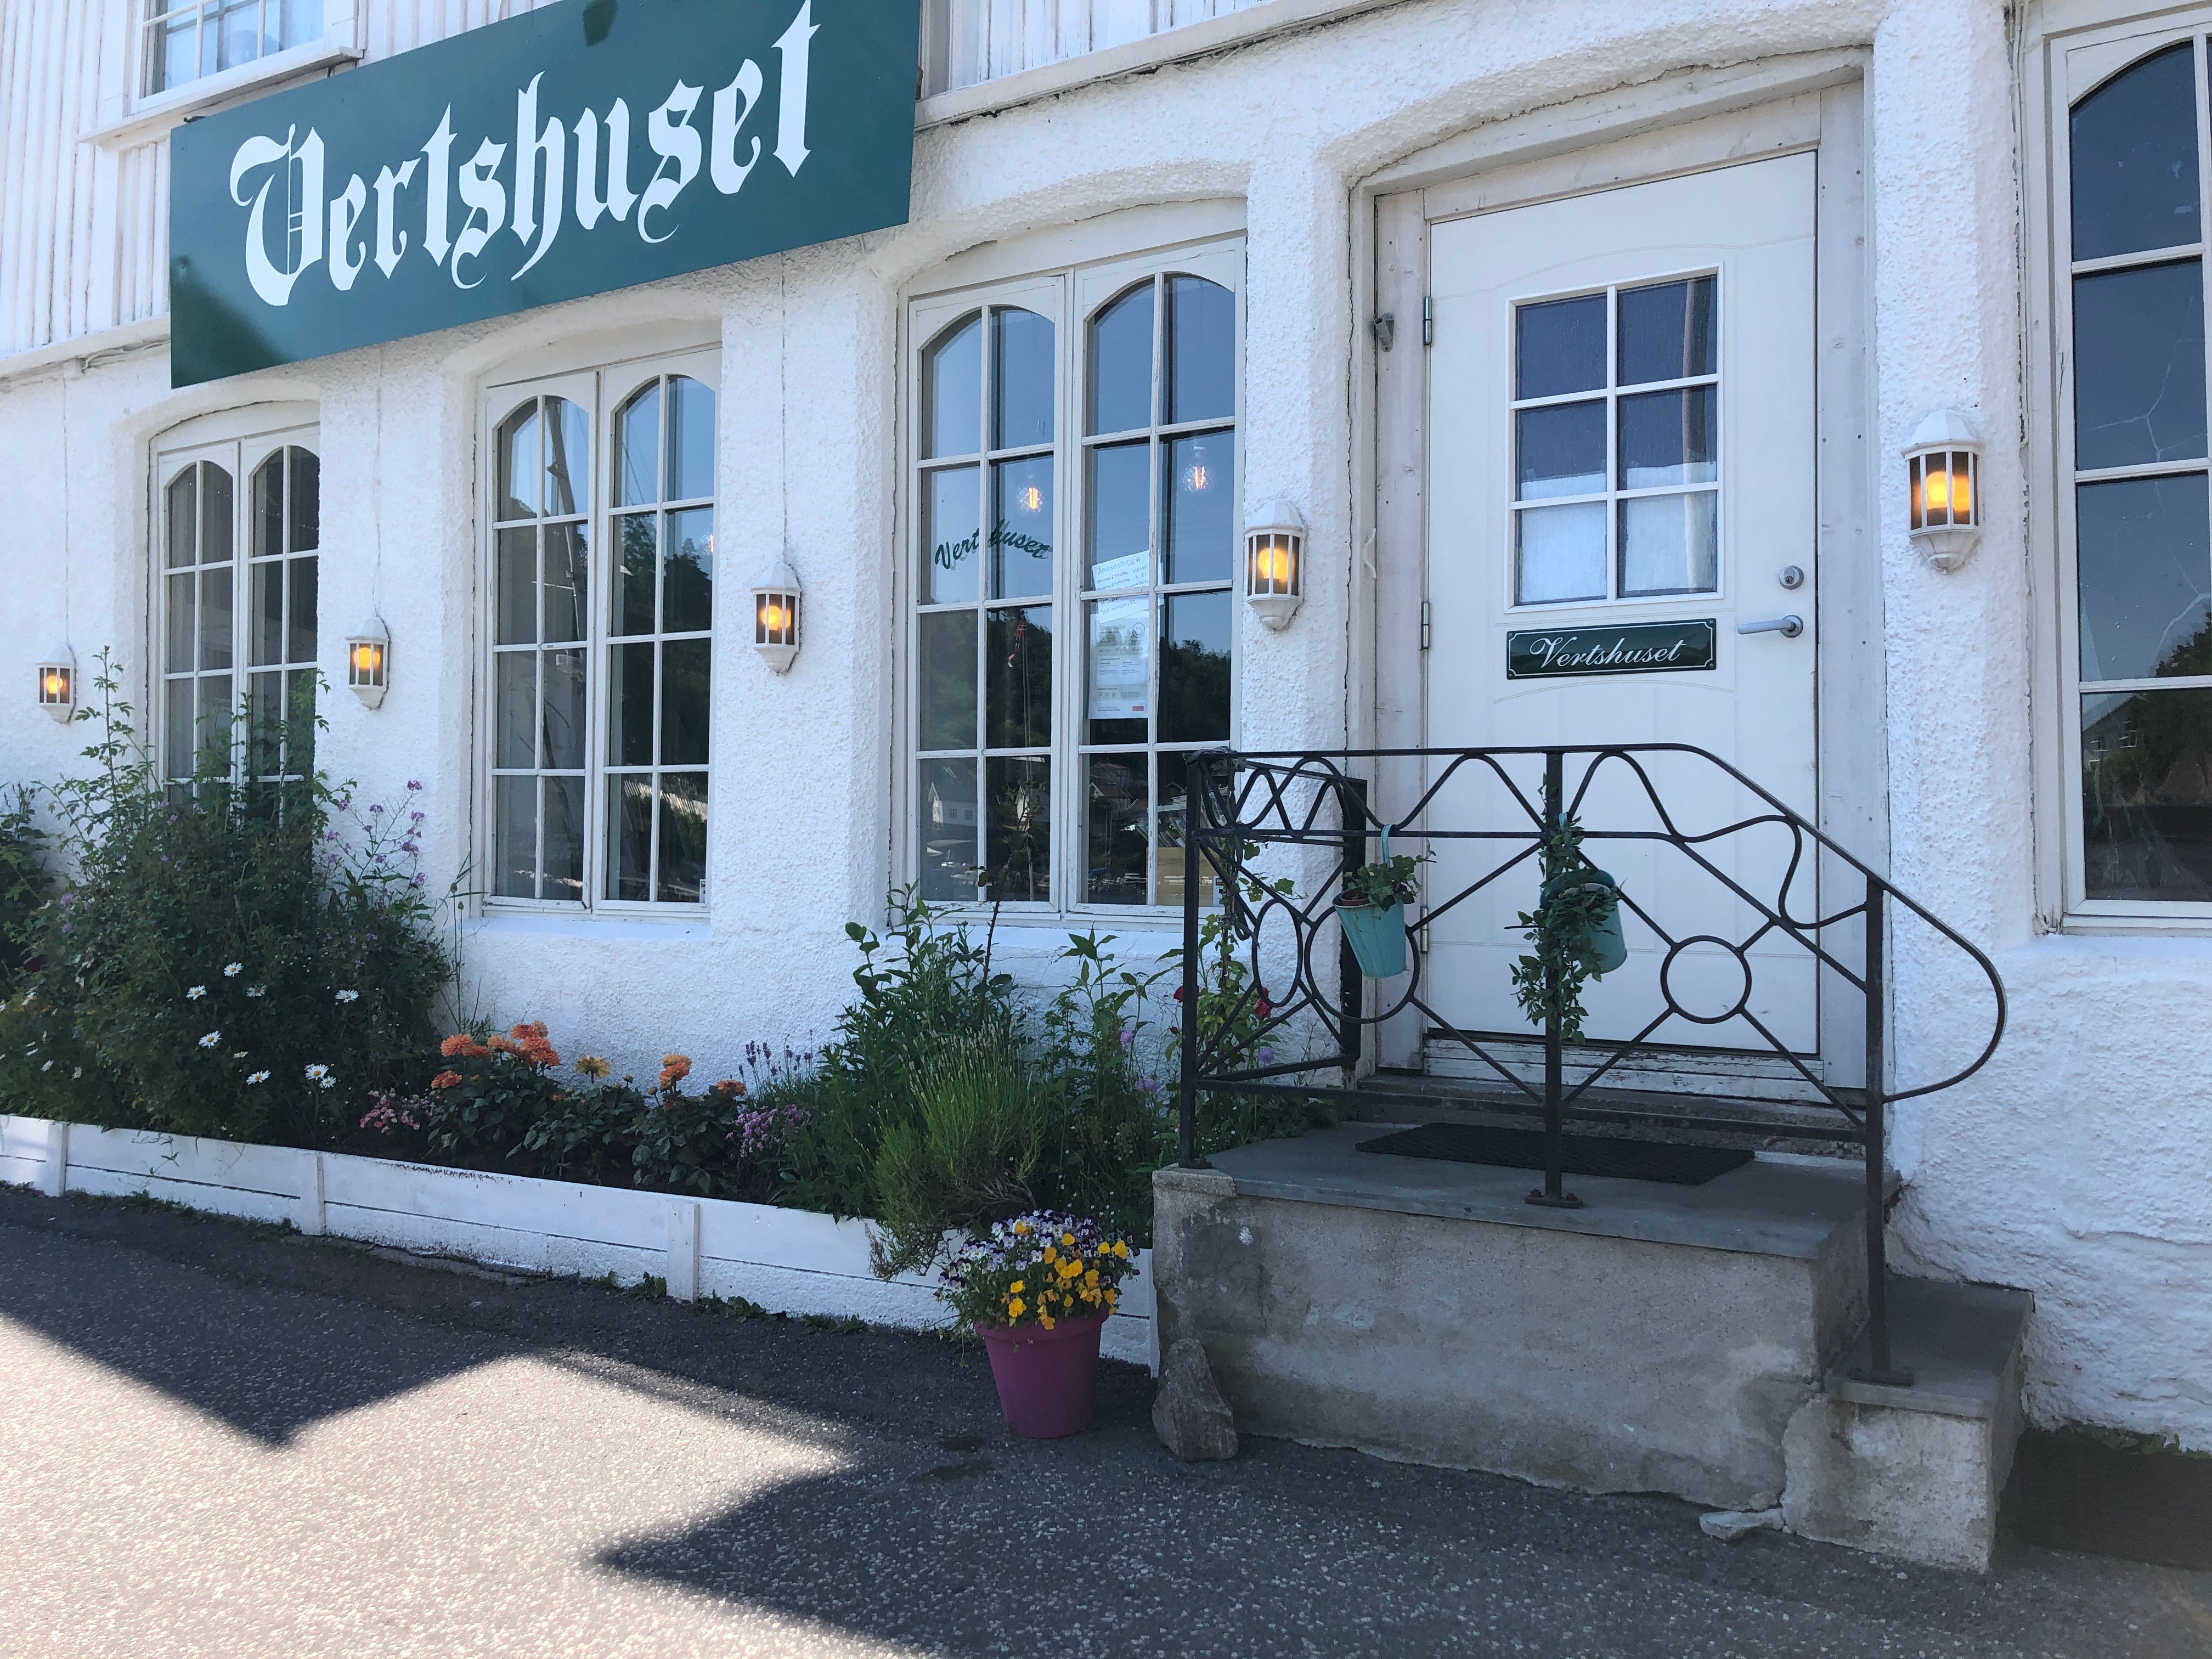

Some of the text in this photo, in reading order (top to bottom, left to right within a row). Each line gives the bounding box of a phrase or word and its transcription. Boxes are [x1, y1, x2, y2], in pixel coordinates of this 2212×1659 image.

[229, 0, 820, 306] Vertshuset
[934, 518, 1049, 569] Verthuset
[1530, 636, 1686, 668] Vertshuset
